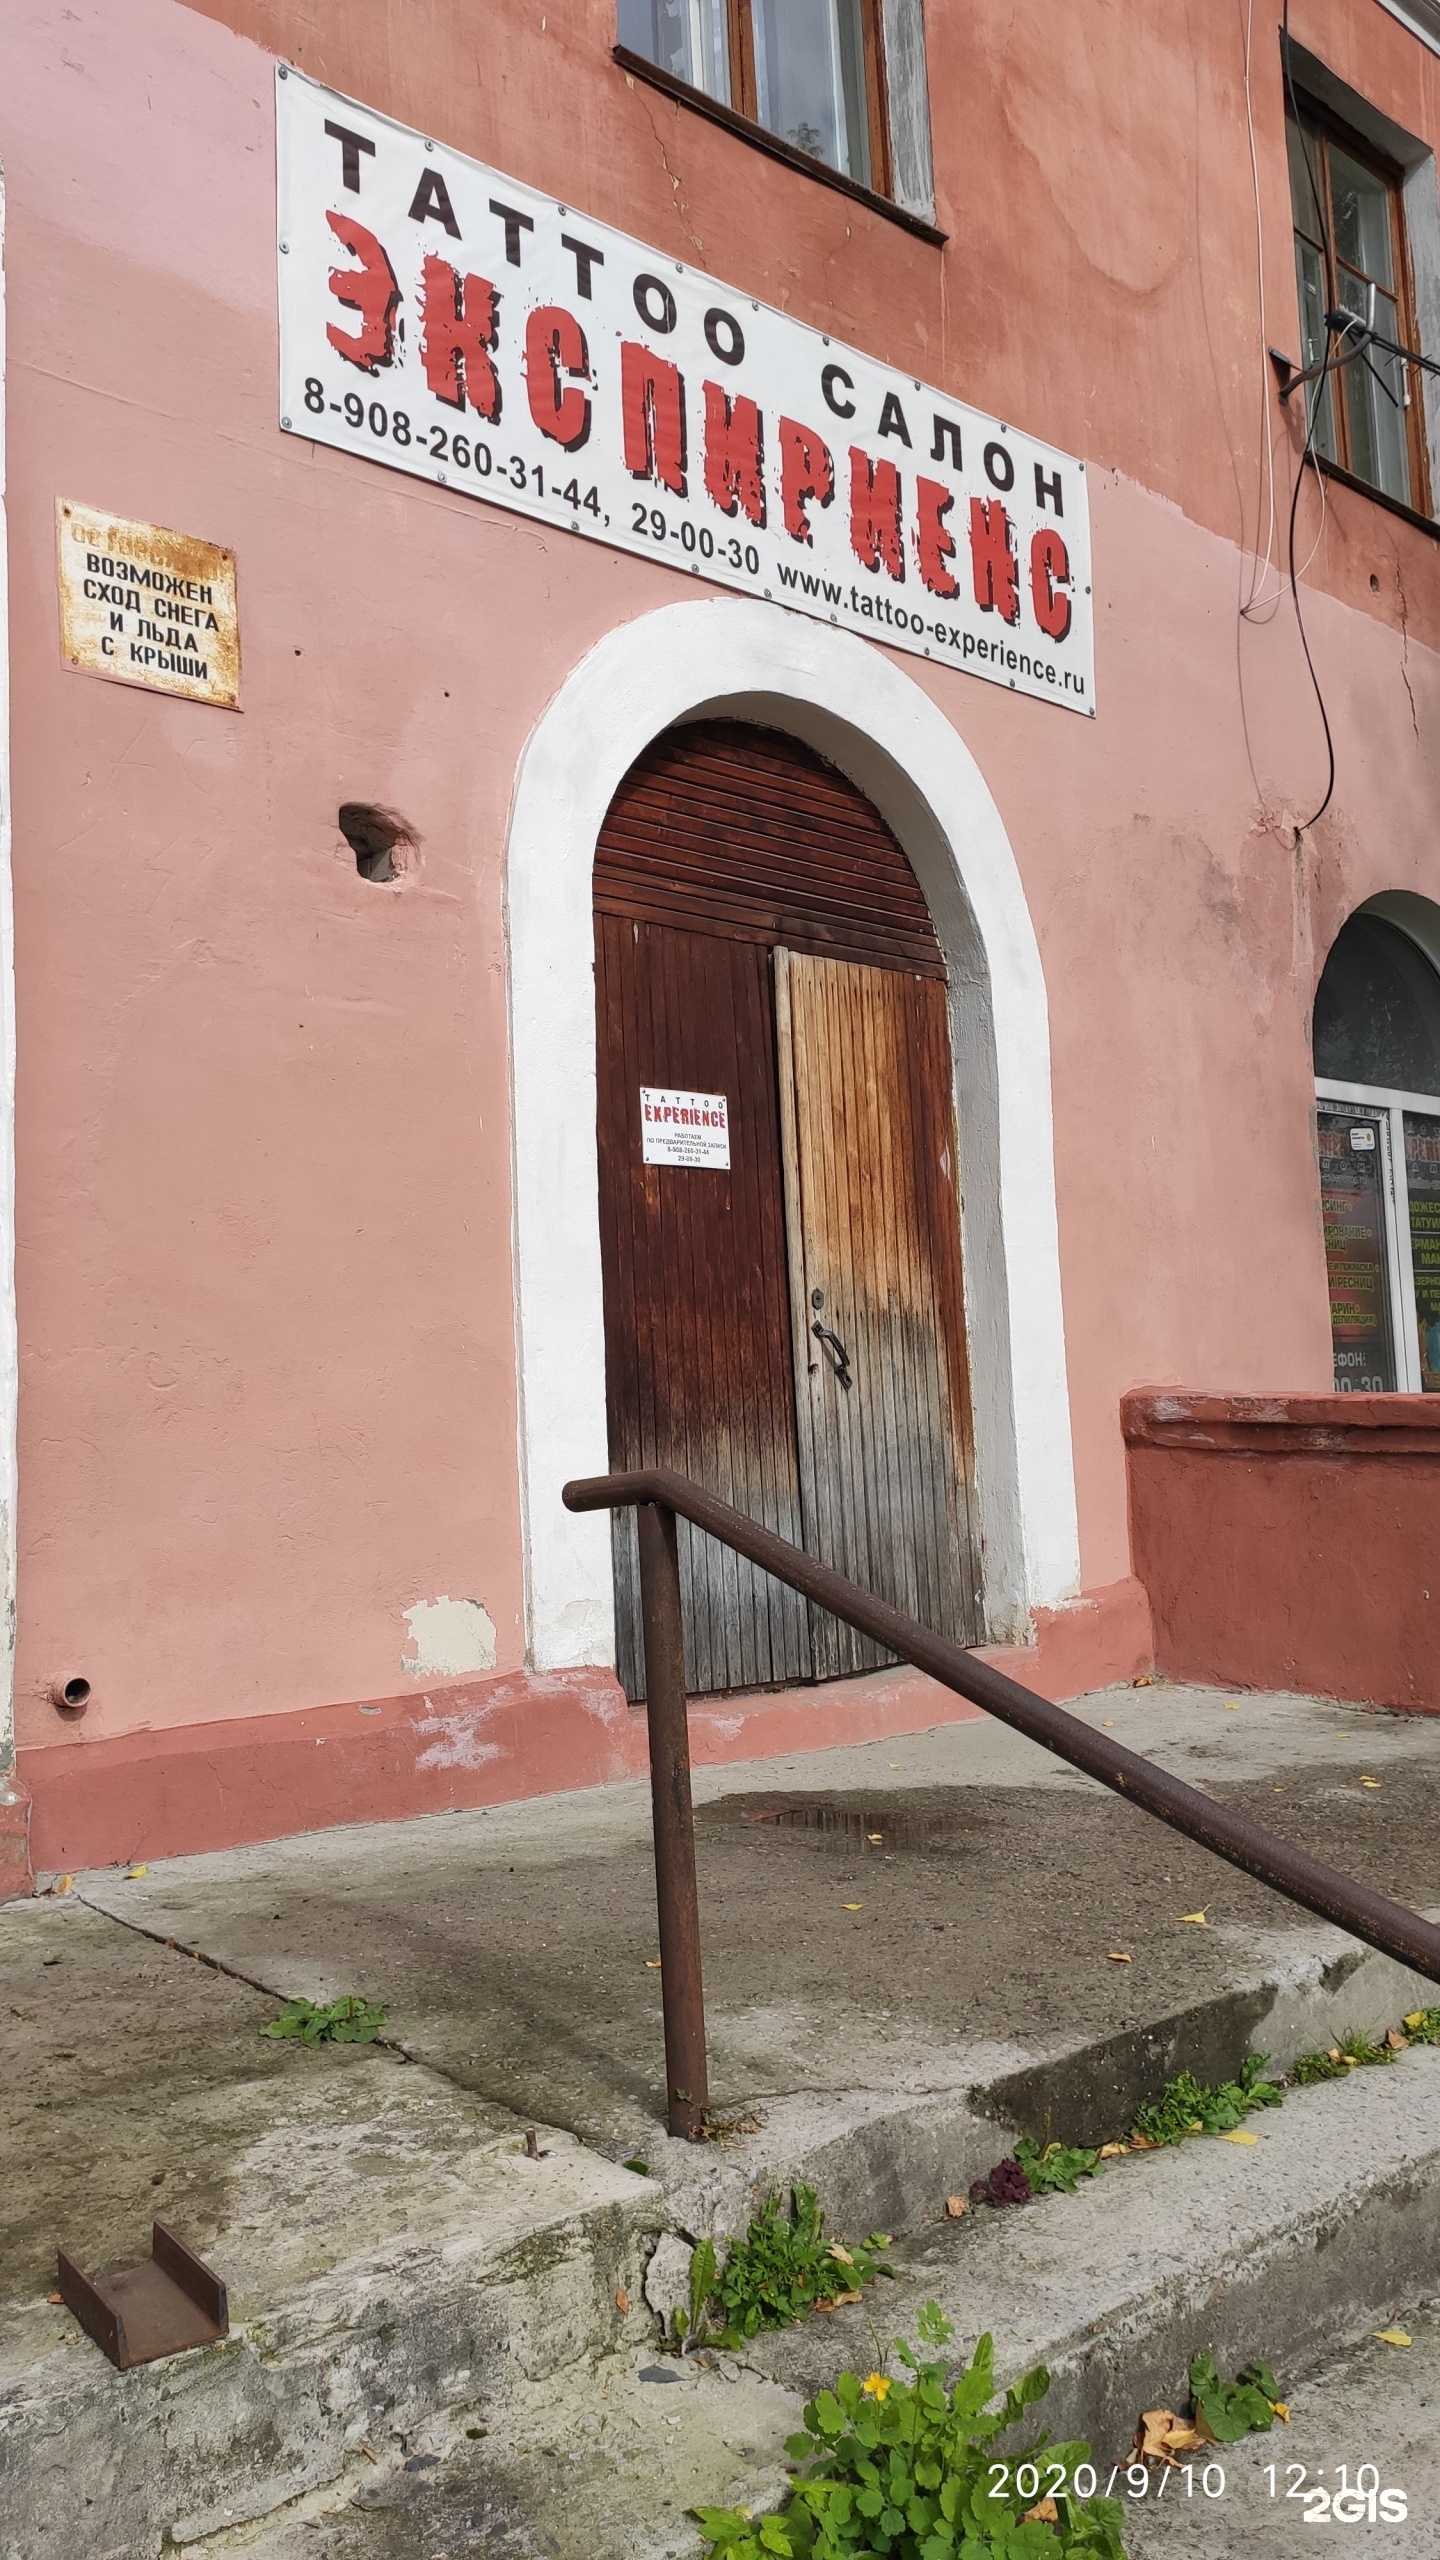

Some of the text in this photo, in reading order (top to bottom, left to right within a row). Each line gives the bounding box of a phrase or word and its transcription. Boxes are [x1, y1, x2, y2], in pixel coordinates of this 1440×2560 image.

[324, 119, 1064, 517] ТАТТОО САЛОН
[325, 210, 1073, 643] ЭКСПИРИЕНС
[304, 378, 1085, 695] 8-908-260-31-44, 29-00-30 www.tattoo-experience.ru
[86, 552, 212, 605] ВОЗМОЖЕН
[83, 579, 220, 632] СХОД СНЕГА
[109, 611, 199, 652] И ЛЬДА
[101, 636, 208, 679] С КРЫШИ
[644, 1104, 726, 1128] EXPERIENCE
[645, 1094, 723, 1109] TATTOO
